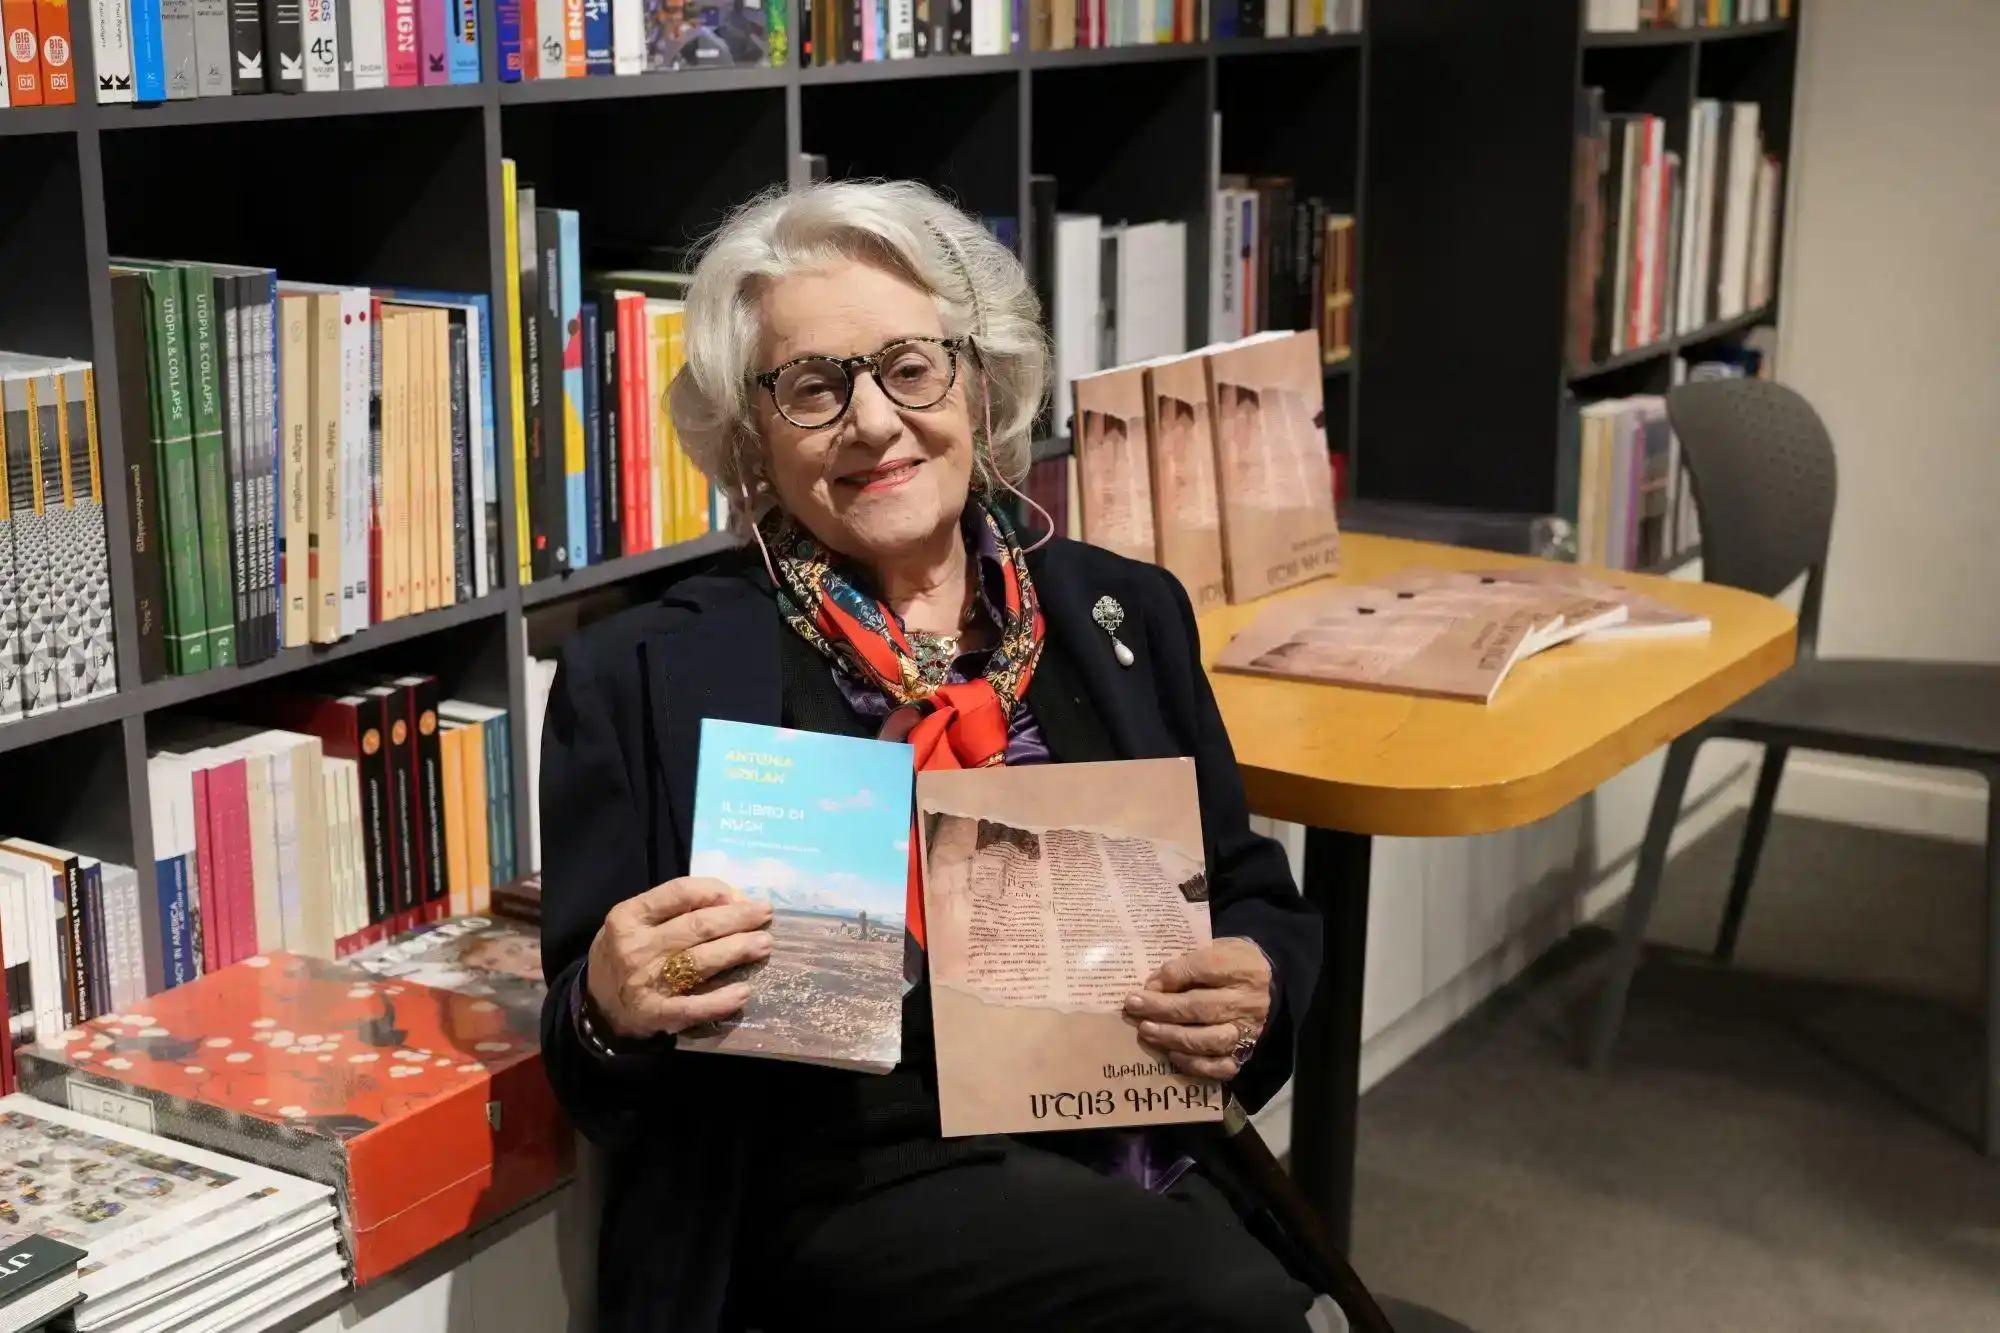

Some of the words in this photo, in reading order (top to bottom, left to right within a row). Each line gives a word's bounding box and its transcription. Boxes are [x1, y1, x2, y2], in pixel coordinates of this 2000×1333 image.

[15, 32, 30, 43] BIG
[49, 39, 63, 49] BIG
[311, 37, 334, 65] 45
[19, 76, 34, 88] DK
[52, 75, 67, 88] DK
[163, 298, 176, 344] UTOPIA
[197, 294, 208, 339] UTOPIA
[168, 347, 178, 356] &
[200, 342, 209, 351] &
[168, 358, 183, 420] COLLAPSE
[200, 353, 214, 415] COLLAPSE
[725, 750, 794, 767] ANTONIA
[721, 800, 732, 813] IL
[739, 802, 784, 819] LIBRO
[788, 809, 804, 820] DI
[720, 818, 763, 834] MUSH
[69, 868, 79, 908] Methods
[73, 917, 81, 956] Theories
[1029, 1089, 1116, 1120] ՄՇՈՅ
[1124, 1084, 1221, 1113] ԳԻՐՔԸ
